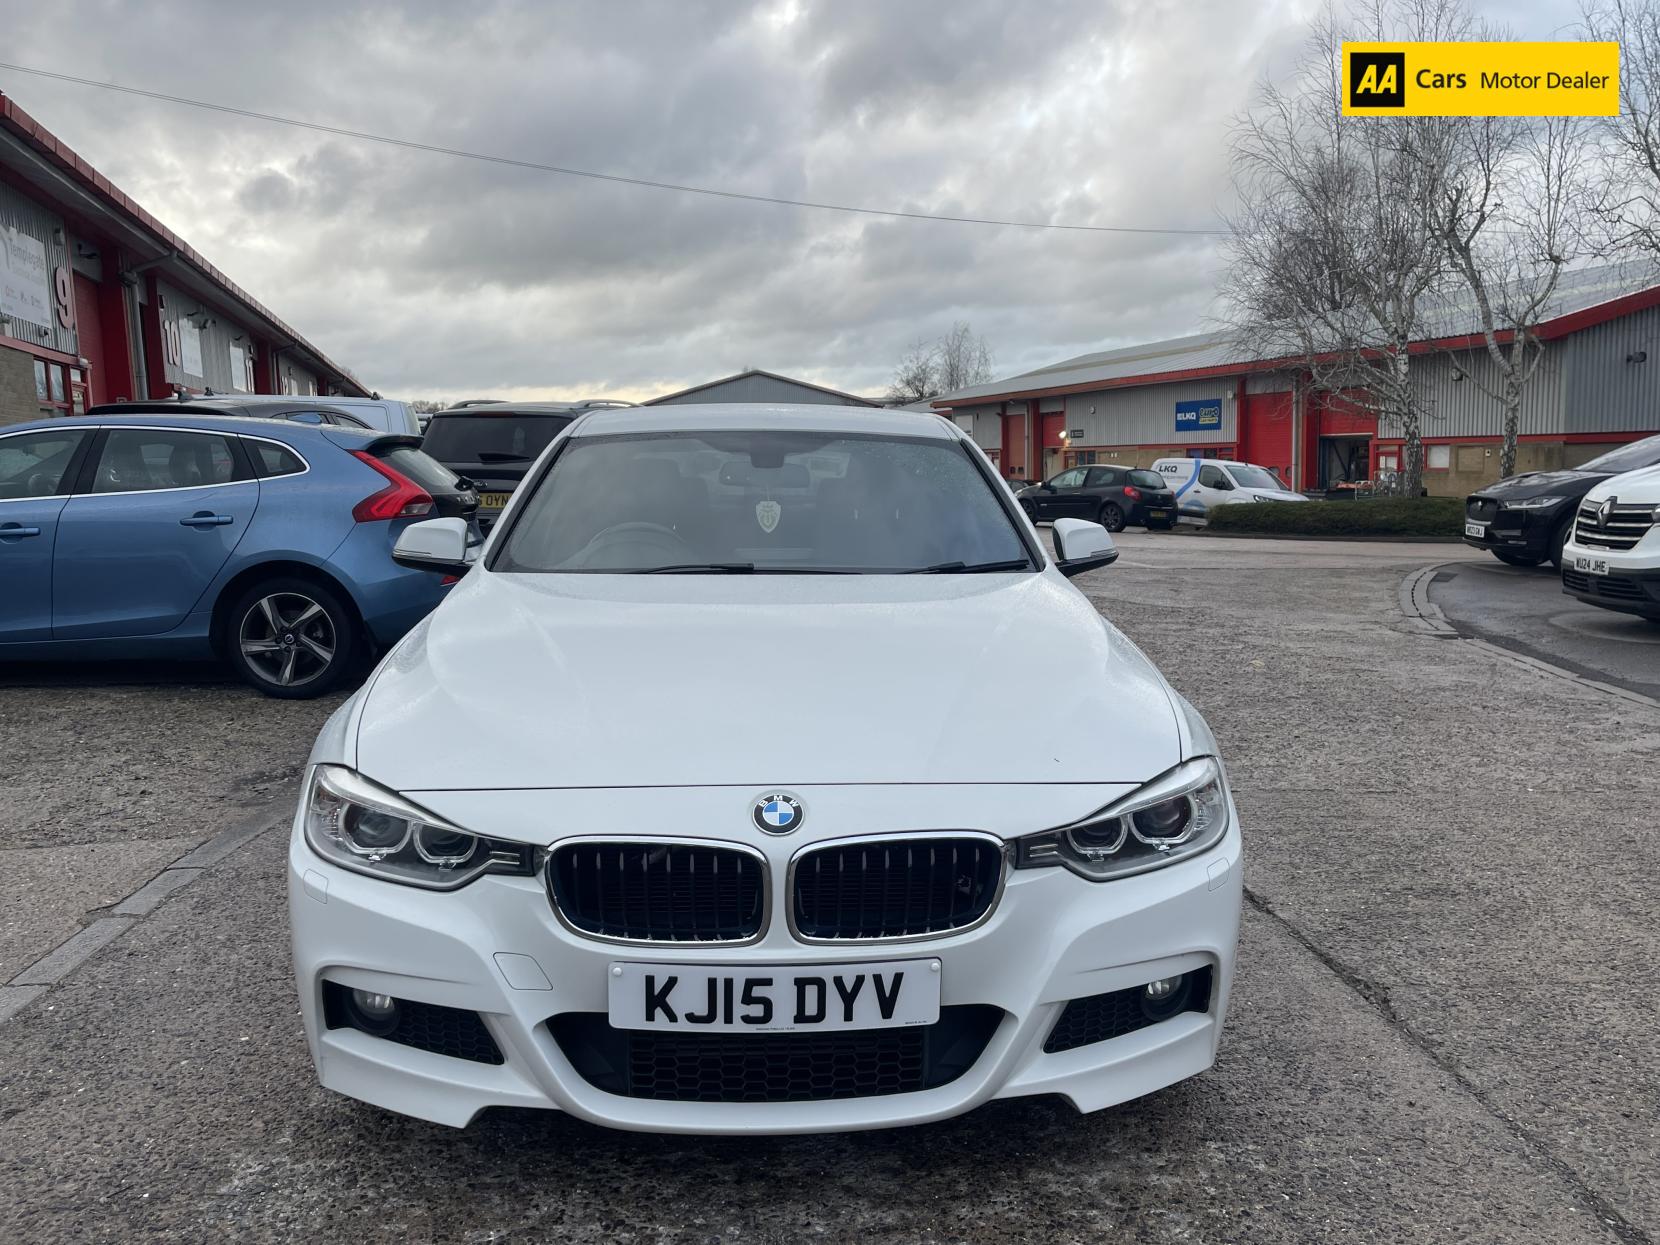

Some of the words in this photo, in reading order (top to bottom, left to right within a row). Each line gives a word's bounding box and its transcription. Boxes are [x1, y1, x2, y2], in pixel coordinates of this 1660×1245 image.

[54, 266, 75, 329] 9
[164, 320, 180, 367] 10
[1159, 465, 1178, 473] LKQ
[758, 795, 800, 808] BMW
[645, 974, 774, 1025] KJ15
[793, 971, 905, 1024] DYV
